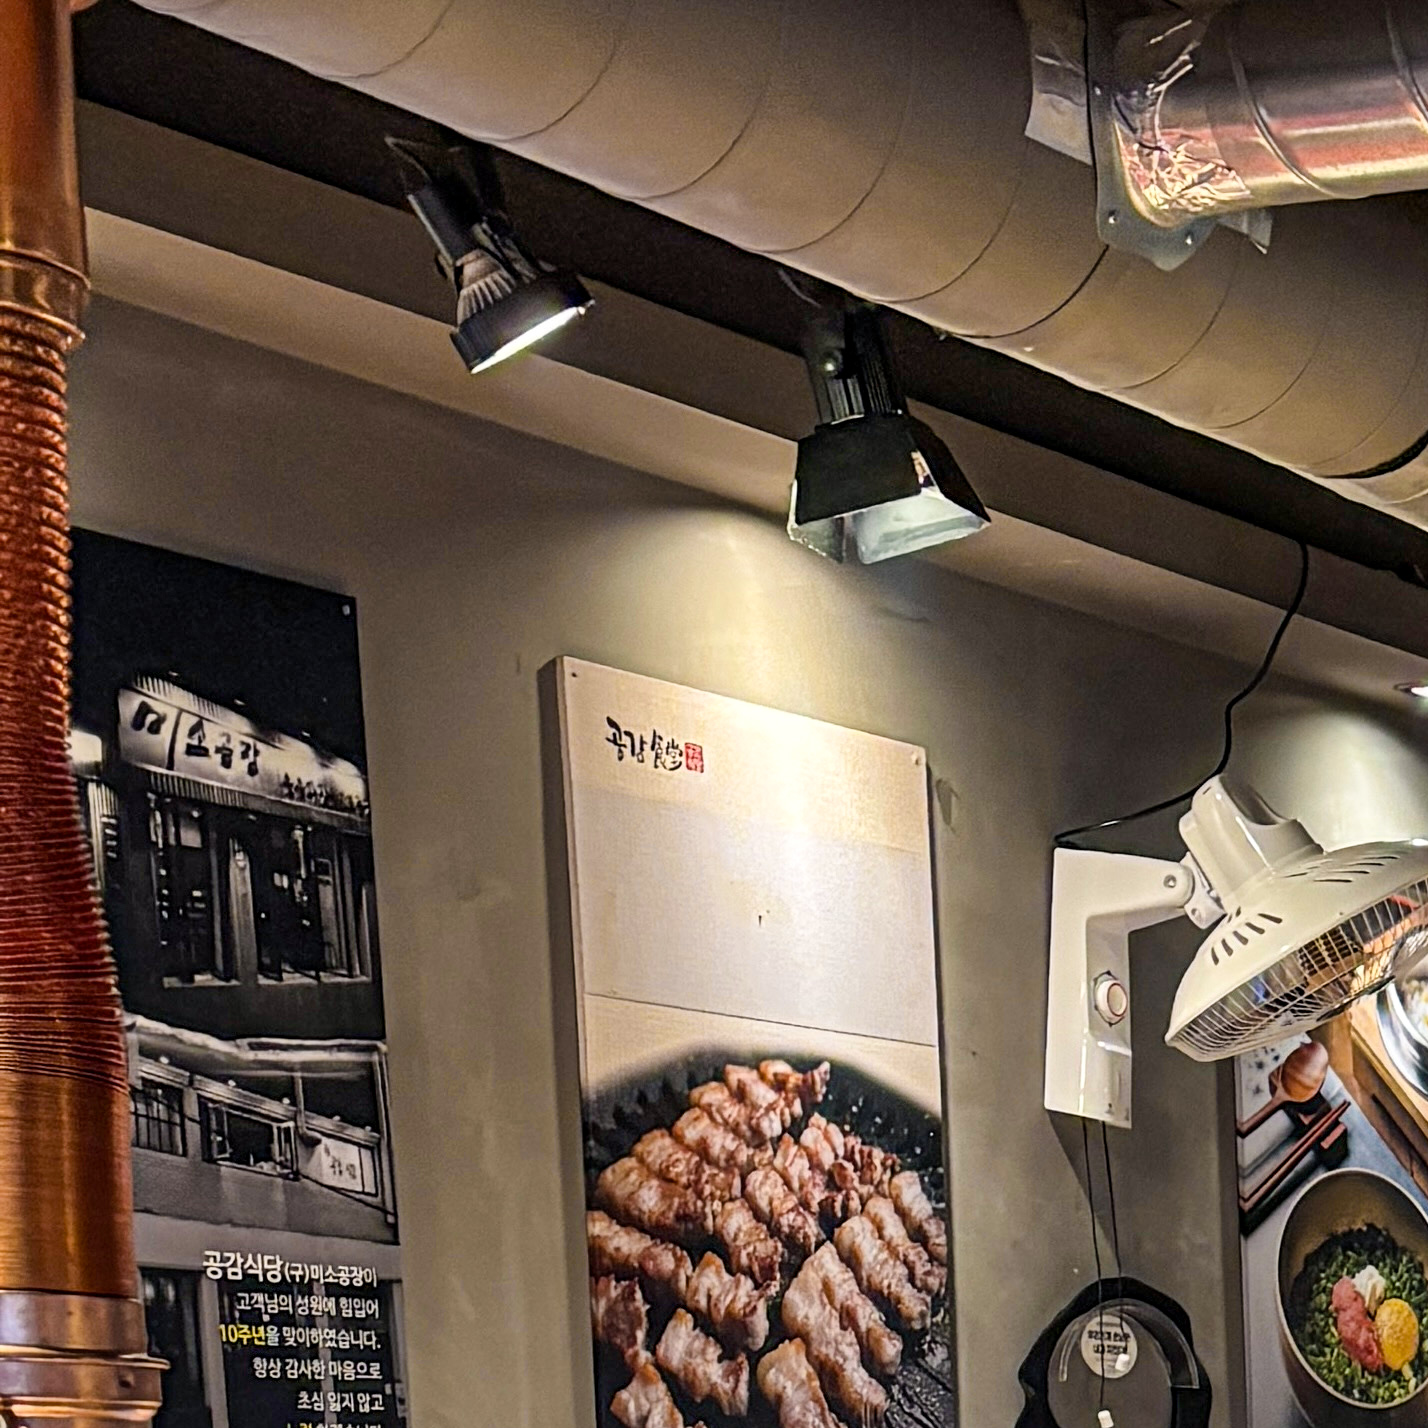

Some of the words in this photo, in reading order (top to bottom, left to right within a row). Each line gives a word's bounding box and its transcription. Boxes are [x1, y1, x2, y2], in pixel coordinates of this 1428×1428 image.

[236, 1292, 293, 1315] 고객님의
[295, 1295, 337, 1316] 성원에
[339, 1297, 379, 1319] 힘입어
[218, 1324, 279, 1346] 10주년을
[282, 1327, 381, 1350] 맞이하였습니다.
[253, 1357, 281, 1379] 항상
[285, 1358, 325, 1380] 감사한
[328, 1360, 382, 1380] 마음으로
[297, 1391, 325, 1412] 초심
[357, 1393, 385, 1413] 않고
